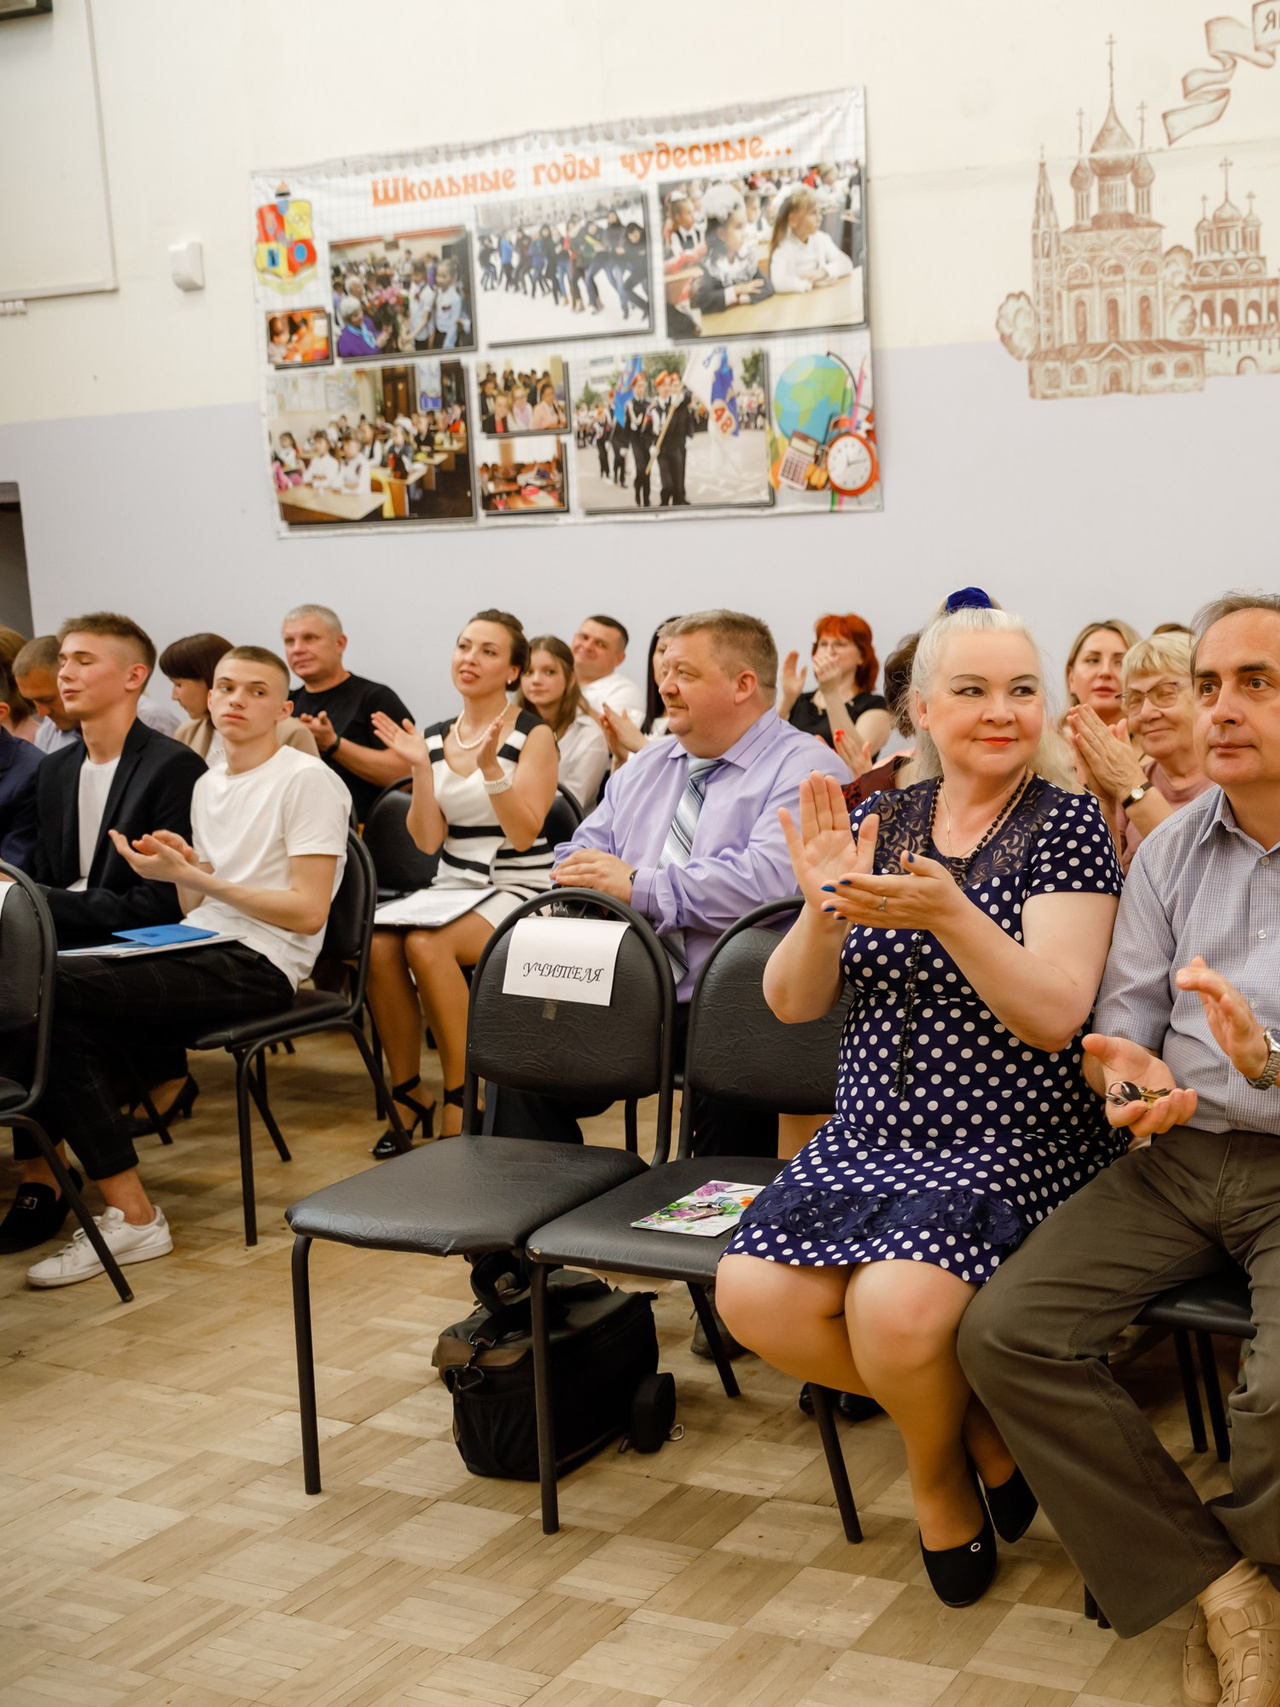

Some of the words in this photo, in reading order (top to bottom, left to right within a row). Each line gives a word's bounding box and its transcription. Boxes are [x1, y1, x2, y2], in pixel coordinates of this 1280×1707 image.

[371, 167, 516, 207] Школьные
[533, 154, 600, 187] годы
[619, 136, 793, 180] чудесные...
[522, 962, 604, 984] УЧИТЕЛЯ
